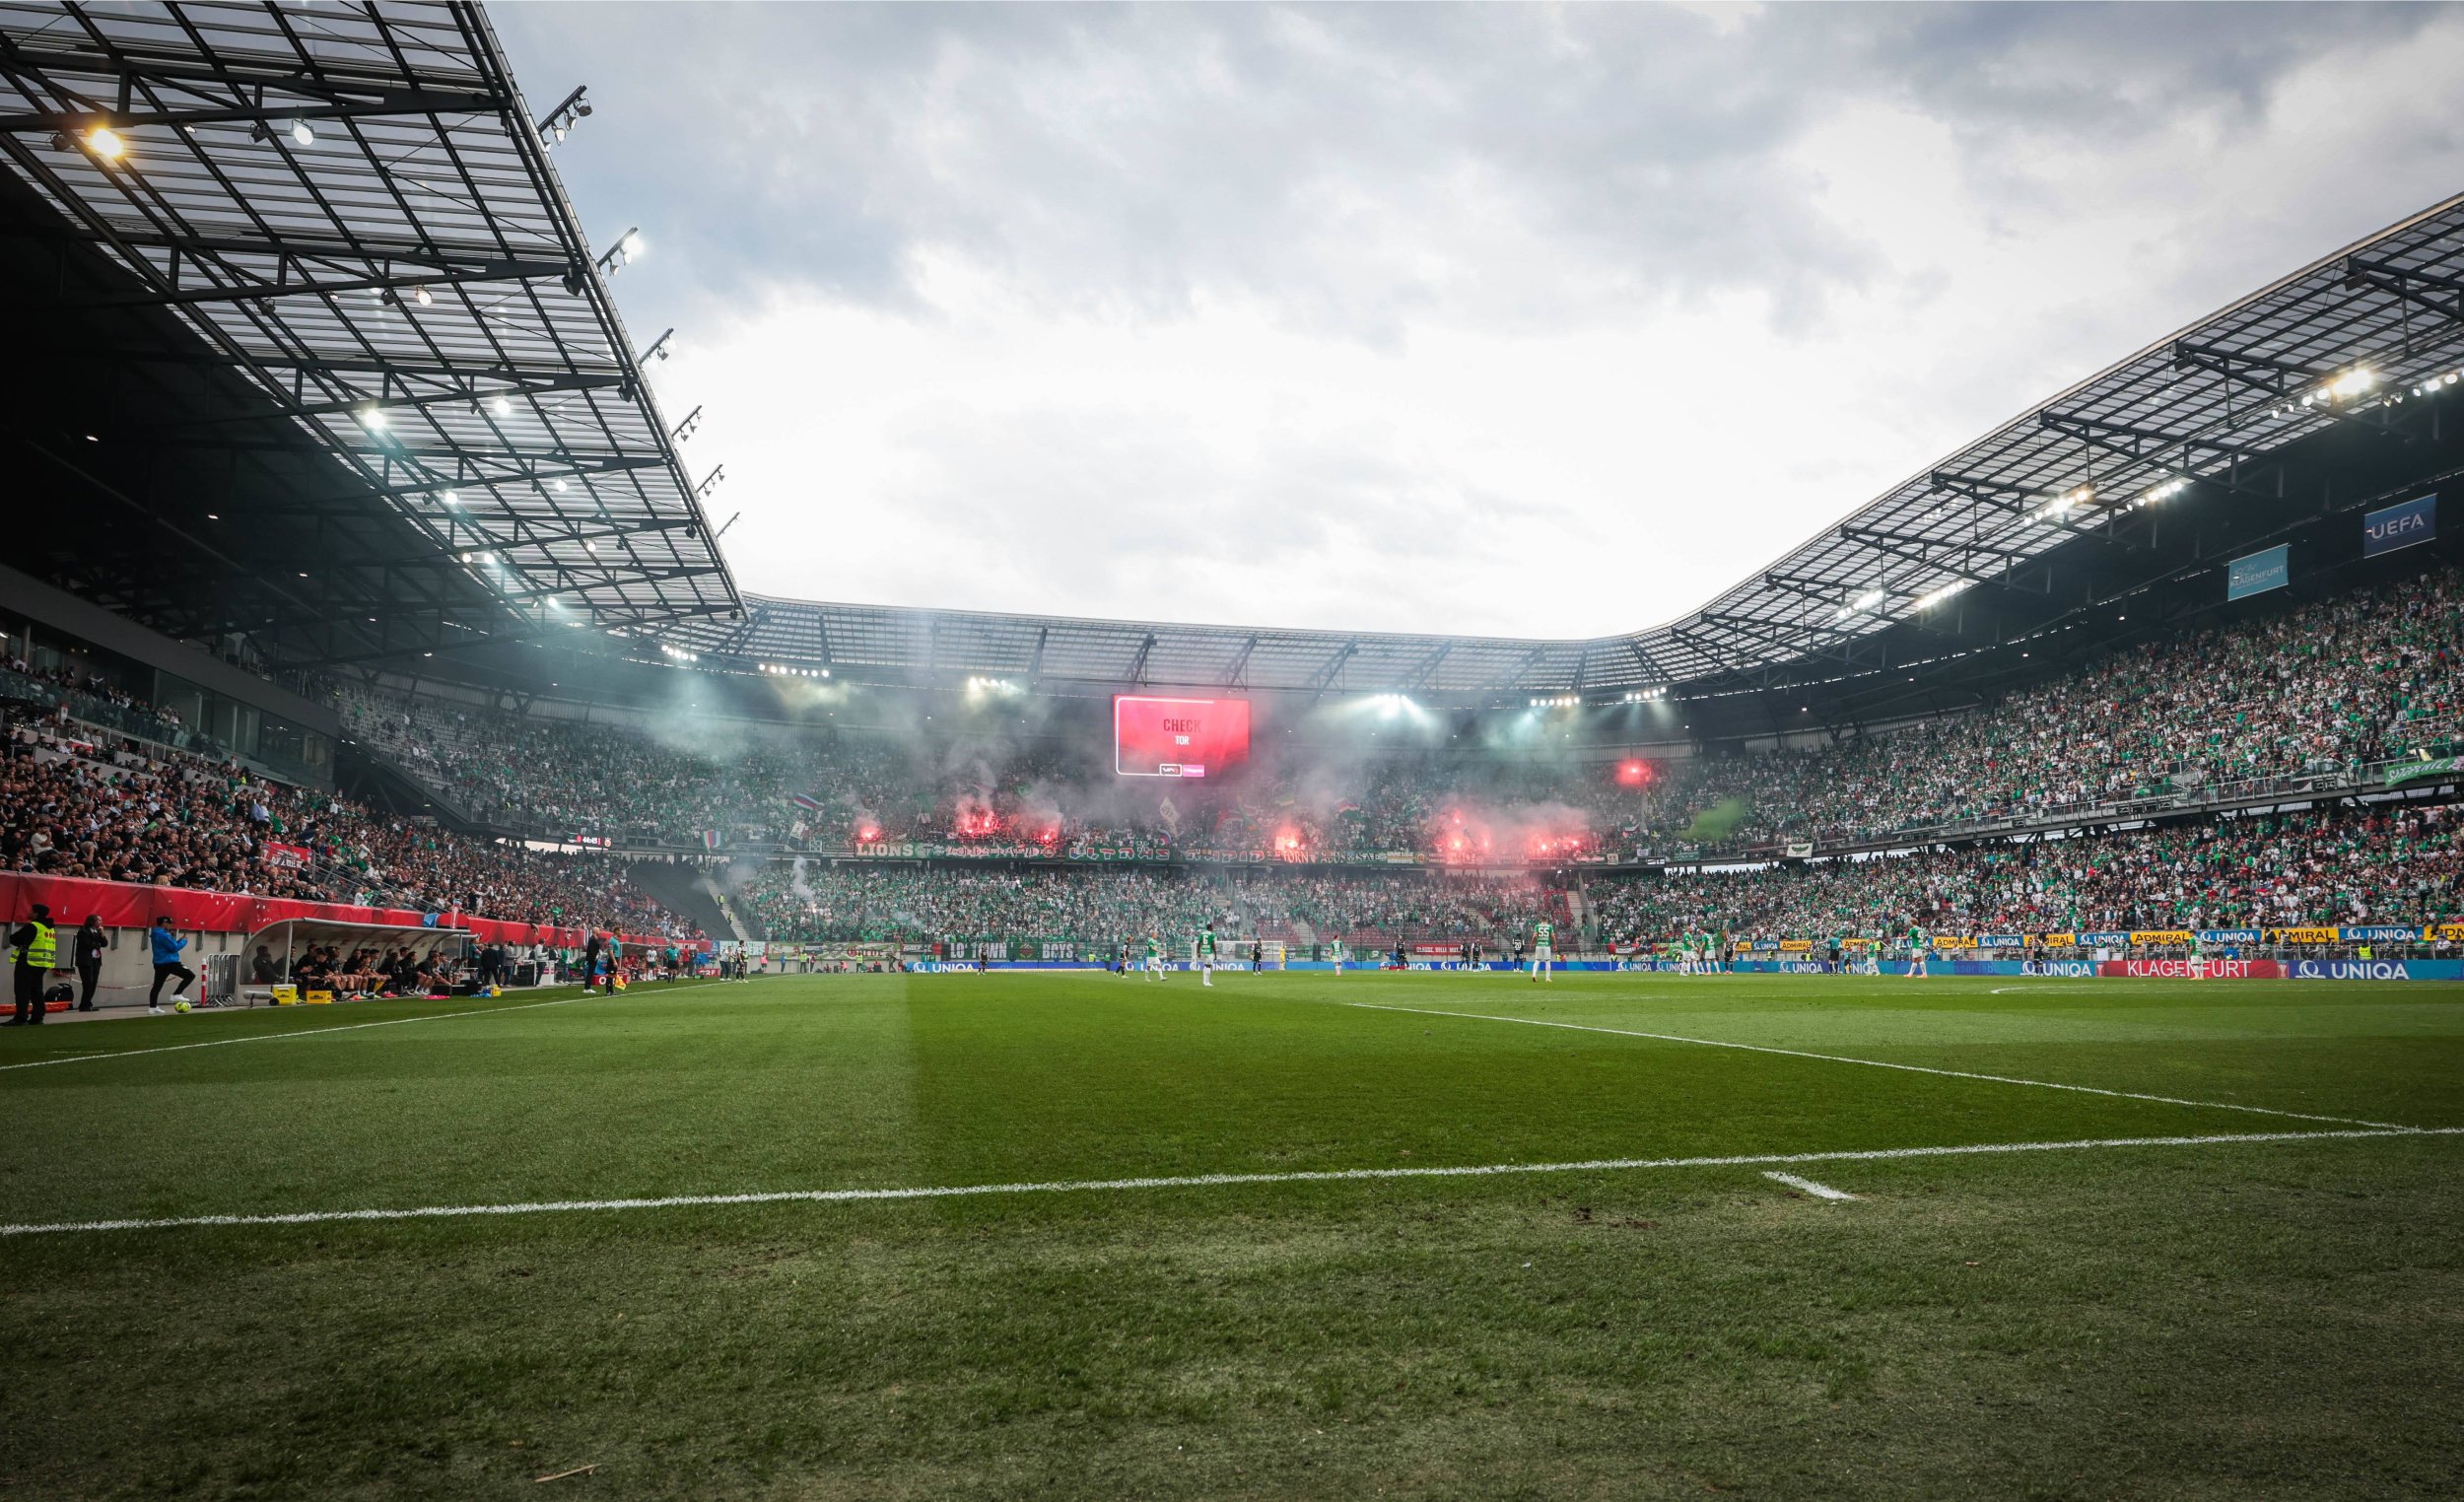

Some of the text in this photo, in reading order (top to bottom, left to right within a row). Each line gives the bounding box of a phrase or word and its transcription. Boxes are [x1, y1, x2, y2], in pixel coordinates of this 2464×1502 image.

[2370, 512, 2425, 539] UEFA
[2229, 565, 2285, 588] KLAGENFURT
[1163, 717, 1201, 733] CHECK
[1175, 735, 1190, 746] TOR
[856, 843, 914, 856] LIONS
[1539, 926, 1549, 936] 55
[2217, 931, 2255, 942] UNIQA
[2367, 927, 2415, 941] UNIQA
[1202, 935, 1208, 944] 6
[1993, 937, 2020, 946] UNIQA
[2027, 935, 2074, 945] AIRAL
[2135, 933, 2187, 943] ADMIRAL
[971, 942, 1007, 959] TWN
[1042, 943, 1073, 959] BOYS
[932, 963, 974, 974] UNIQA
[1629, 962, 1652, 972] UNIQA
[1792, 962, 1823, 974] UNIQA
[1852, 963, 1880, 974] NIQA
[2042, 962, 2092, 977] UNIQA
[2127, 960, 2251, 977] KLAGENFURT
[2331, 962, 2410, 980] UNIQA
